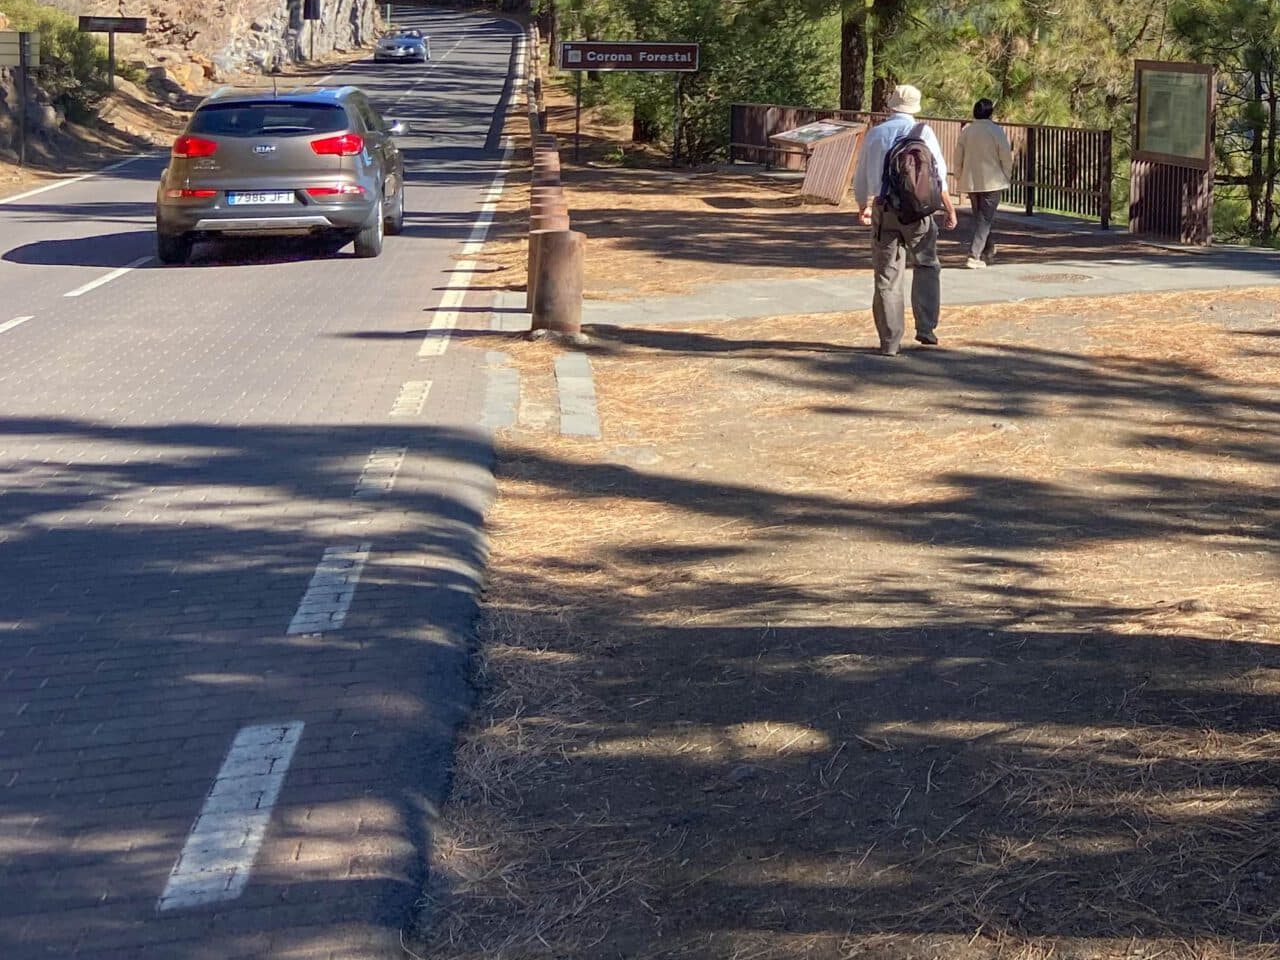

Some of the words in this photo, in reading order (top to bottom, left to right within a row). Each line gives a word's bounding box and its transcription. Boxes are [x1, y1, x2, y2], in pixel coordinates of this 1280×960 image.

[586, 51, 633, 62] Corona
[639, 51, 692, 62] Forestal
[237, 192, 266, 202] 7986
